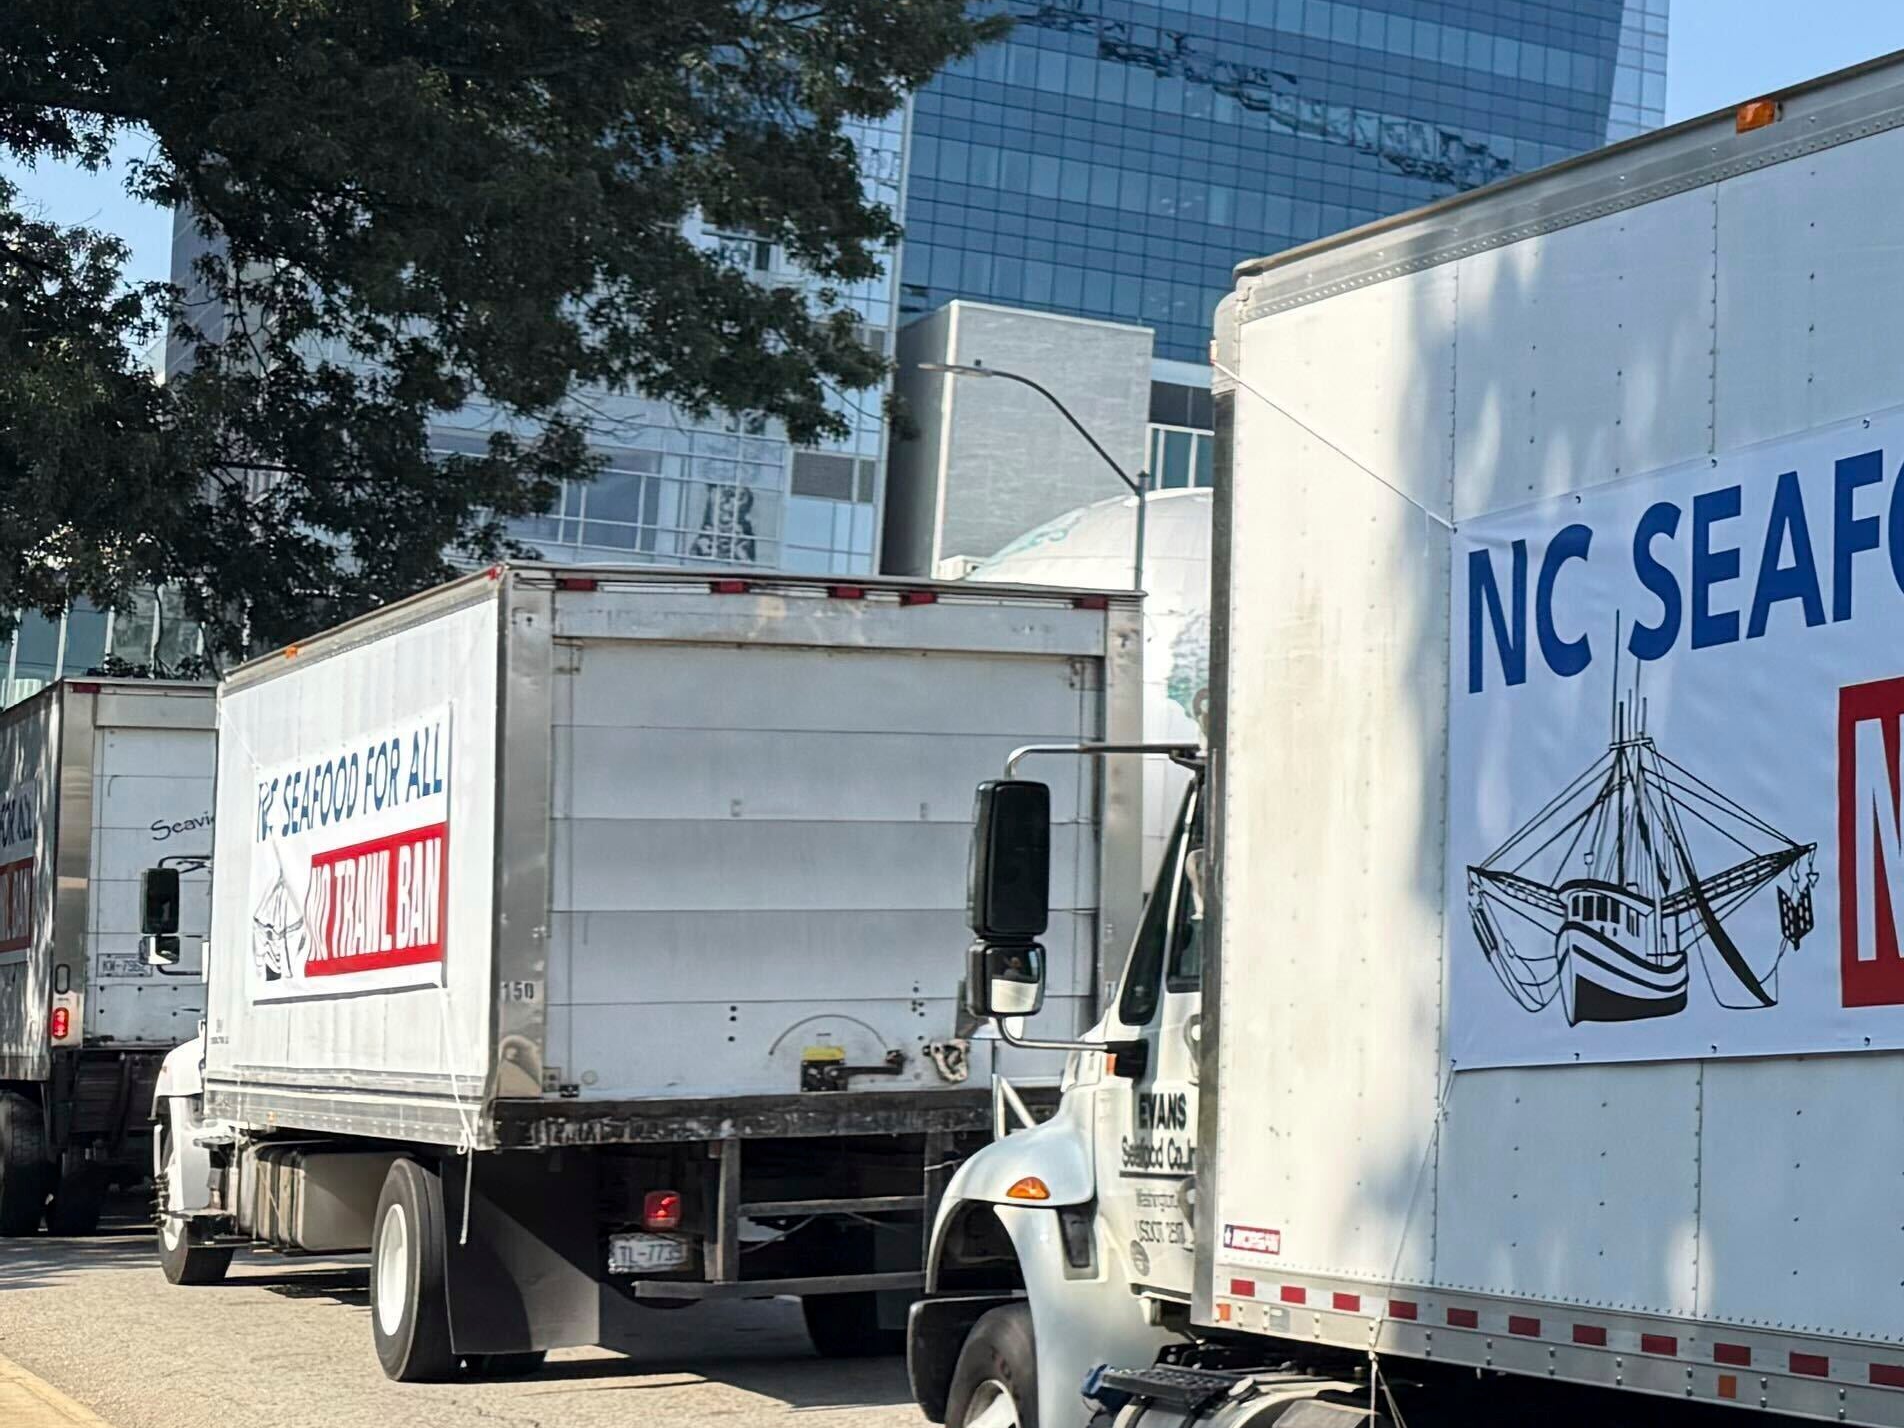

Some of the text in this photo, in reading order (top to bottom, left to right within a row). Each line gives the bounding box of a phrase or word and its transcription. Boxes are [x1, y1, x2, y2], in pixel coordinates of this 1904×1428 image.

[1467, 522, 1595, 695] NC
[282, 751, 359, 838] SEAFOOD
[363, 737, 401, 816] FOR
[406, 722, 444, 804] ALL
[150, 810, 216, 841] Seavi
[308, 837, 442, 962] NO TRAWL BAN
[503, 981, 535, 1002] 150
[1138, 1091, 1188, 1131] EVANS
[1121, 1135, 1164, 1170] Seafood
